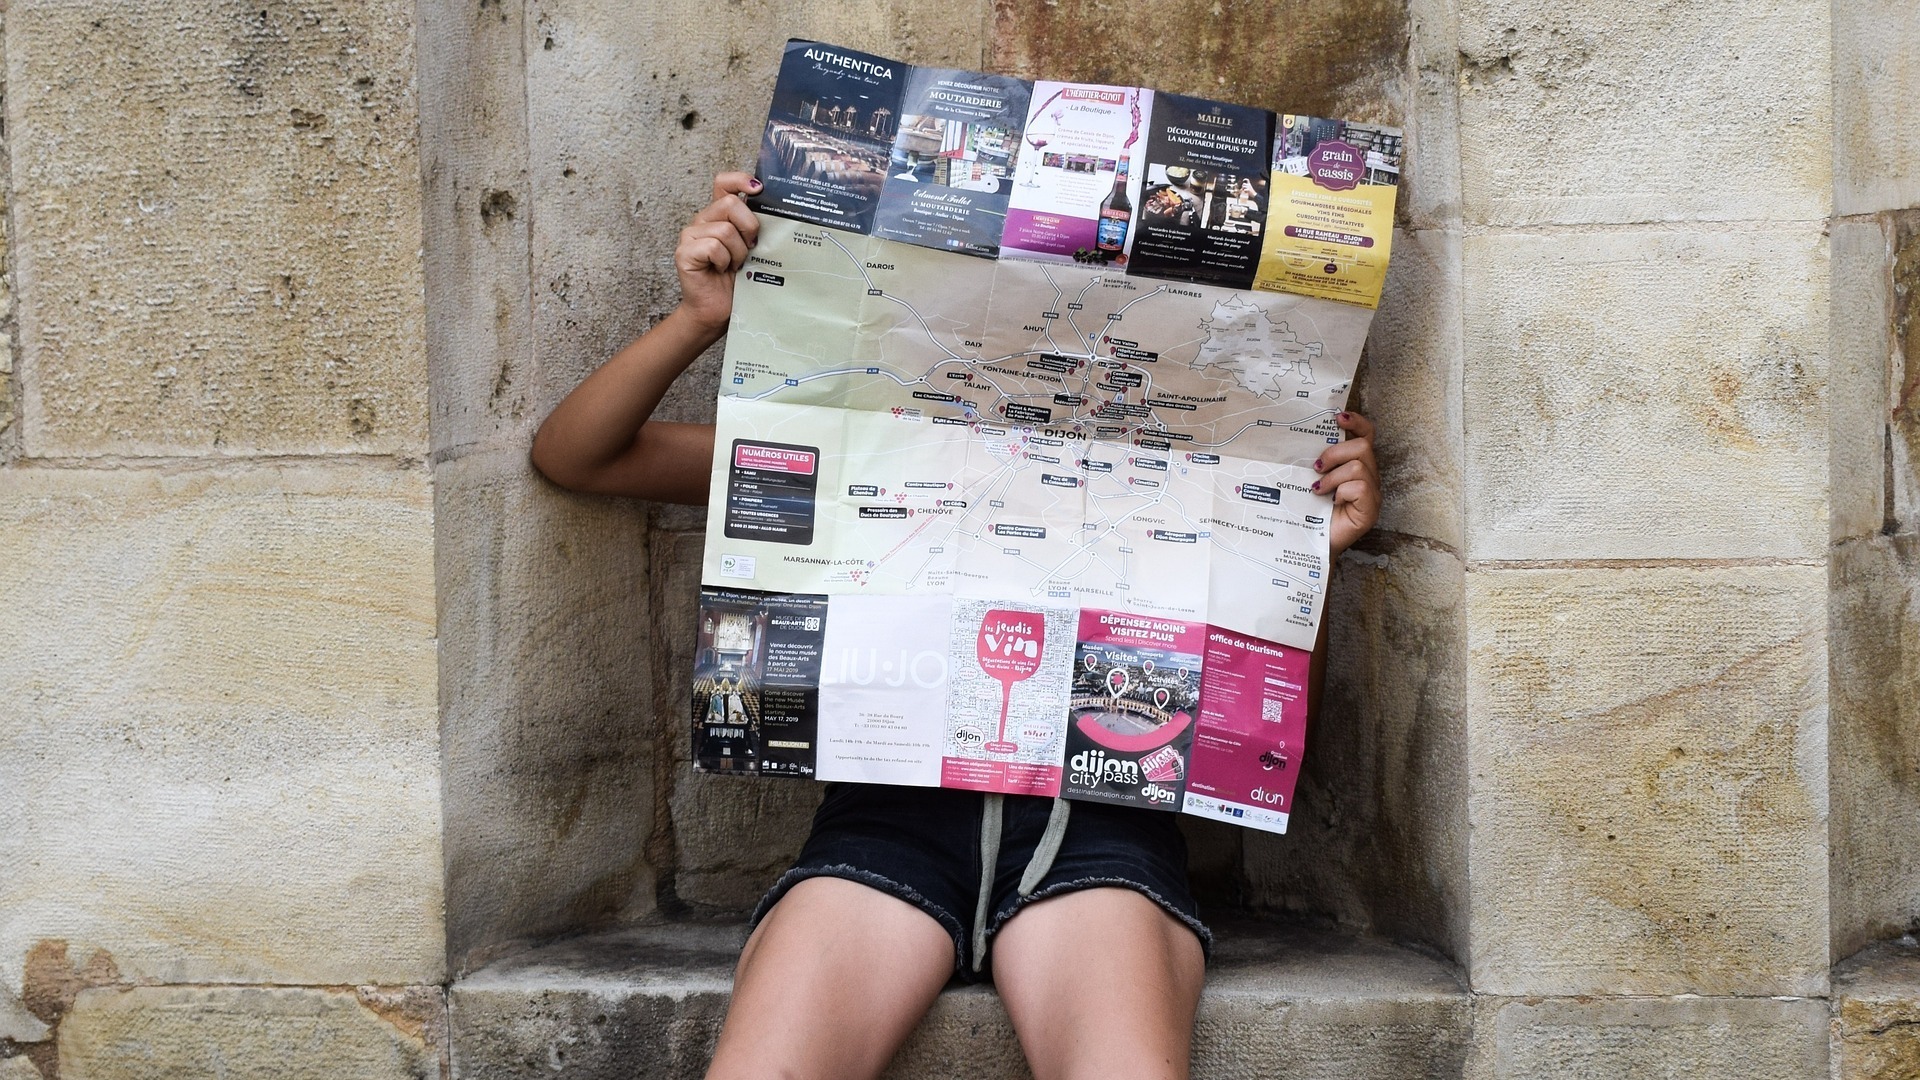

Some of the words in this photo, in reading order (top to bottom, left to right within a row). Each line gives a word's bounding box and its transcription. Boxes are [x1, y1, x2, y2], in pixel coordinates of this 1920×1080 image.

[804, 48, 892, 80] AUTHENTICA
[953, 82, 982, 91] DÉCOUVRIR
[983, 86, 1000, 94] NOTRE
[929, 91, 1002, 109] MOUTARDERIE
[1080, 105, 1112, 115] Boutique
[1197, 113, 1233, 127] MAILLE
[1167, 126, 1207, 139] DÉCOUVREZ
[1208, 133, 1216, 141] LE
[1217, 135, 1248, 146] MEILLEUR
[1177, 137, 1215, 149] MOUTARDE
[1216, 142, 1240, 153] DEPUIS
[1241, 146, 1256, 154] 1747
[1212, 155, 1233, 163] boutique
[1322, 149, 1353, 163] grain
[1318, 167, 1354, 181] cassis
[792, 174, 809, 183] DÉPART
[831, 183, 846, 191] JOURS
[790, 193, 817, 204] Réservation
[820, 200, 838, 209] Booking
[913, 189, 947, 202] Edmond
[919, 201, 970, 216] MOUTARDERIE
[1291, 199, 1336, 210] GOURMANDISES
[1337, 205, 1372, 215] RÉGIONALES
[1317, 209, 1330, 217] VINS
[1331, 211, 1345, 219] FINS
[1296, 213, 1330, 223] CURIOSITÉS
[1331, 218, 1364, 228] GUSTATIVES
[793, 237, 822, 247] TROYES
[804, 233, 823, 241] Suzon
[1315, 230, 1340, 239] RAMEAU
[1343, 234, 1363, 242] DIJON
[751, 256, 782, 268] PRENOIS
[866, 262, 895, 271] DAROIS
[1168, 288, 1202, 299] LANGRES
[965, 340, 983, 348] DAIX
[735, 360, 770, 369] Sombernon
[734, 366, 788, 378] Pouilly-en-Auxois
[734, 371, 755, 379] PARIS
[982, 365, 1061, 383] FONTAINE-LÈS-DIJON
[963, 381, 991, 392] TALANT
[1157, 392, 1227, 402] SAINT-APOLLINAIRE
[1045, 429, 1086, 441] DIJON
[1290, 427, 1340, 438] LUXEMBOURG
[742, 448, 782, 459] NUMÉROS
[783, 453, 809, 462] UTILES
[1277, 482, 1312, 493] QUETIGNY
[917, 507, 953, 515] CHENÔVE
[1132, 515, 1166, 525] LONGVIC
[1199, 518, 1274, 538] SENNECEY-LES-DIJON
[1283, 549, 1321, 560] BESANÇON
[1284, 554, 1321, 565] MULHOUSE
[783, 556, 864, 566] MARSANNAY-LA-CÔTE
[1275, 557, 1321, 571] STRASBOURG
[1074, 587, 1114, 597] MARSEILLE
[1297, 591, 1314, 600] DOLE
[1287, 595, 1313, 607] GENÈVE
[984, 624, 993, 632] les
[995, 621, 1032, 635] jeudis
[1100, 614, 1151, 629] DÉPENSEZ
[1153, 621, 1186, 634] MOINS
[1285, 618, 1308, 627] Auxonne
[1110, 626, 1148, 639] VISITEZ
[1150, 631, 1174, 642] PLUS
[1105, 635, 1124, 644] Spend
[1138, 638, 1161, 647] Discover
[1210, 633, 1233, 646] office
[1234, 639, 1245, 649] de
[1246, 643, 1283, 658] tourisme
[1082, 643, 1103, 652] Musées
[1105, 651, 1138, 663] Visites
[1136, 650, 1164, 659] Transports
[1148, 675, 1178, 685] Activités
[956, 730, 981, 741] dijon
[1070, 750, 1138, 778] dijon
[1141, 747, 1173, 773] dijon
[1259, 750, 1286, 769] dijon
[800, 766, 814, 775] Dijon
[1069, 771, 1101, 789] city
[1103, 770, 1138, 785] pass
[1141, 783, 1176, 801] dijon
[1191, 782, 1216, 791] destination
[1067, 787, 1136, 801] destinationdijon.com
